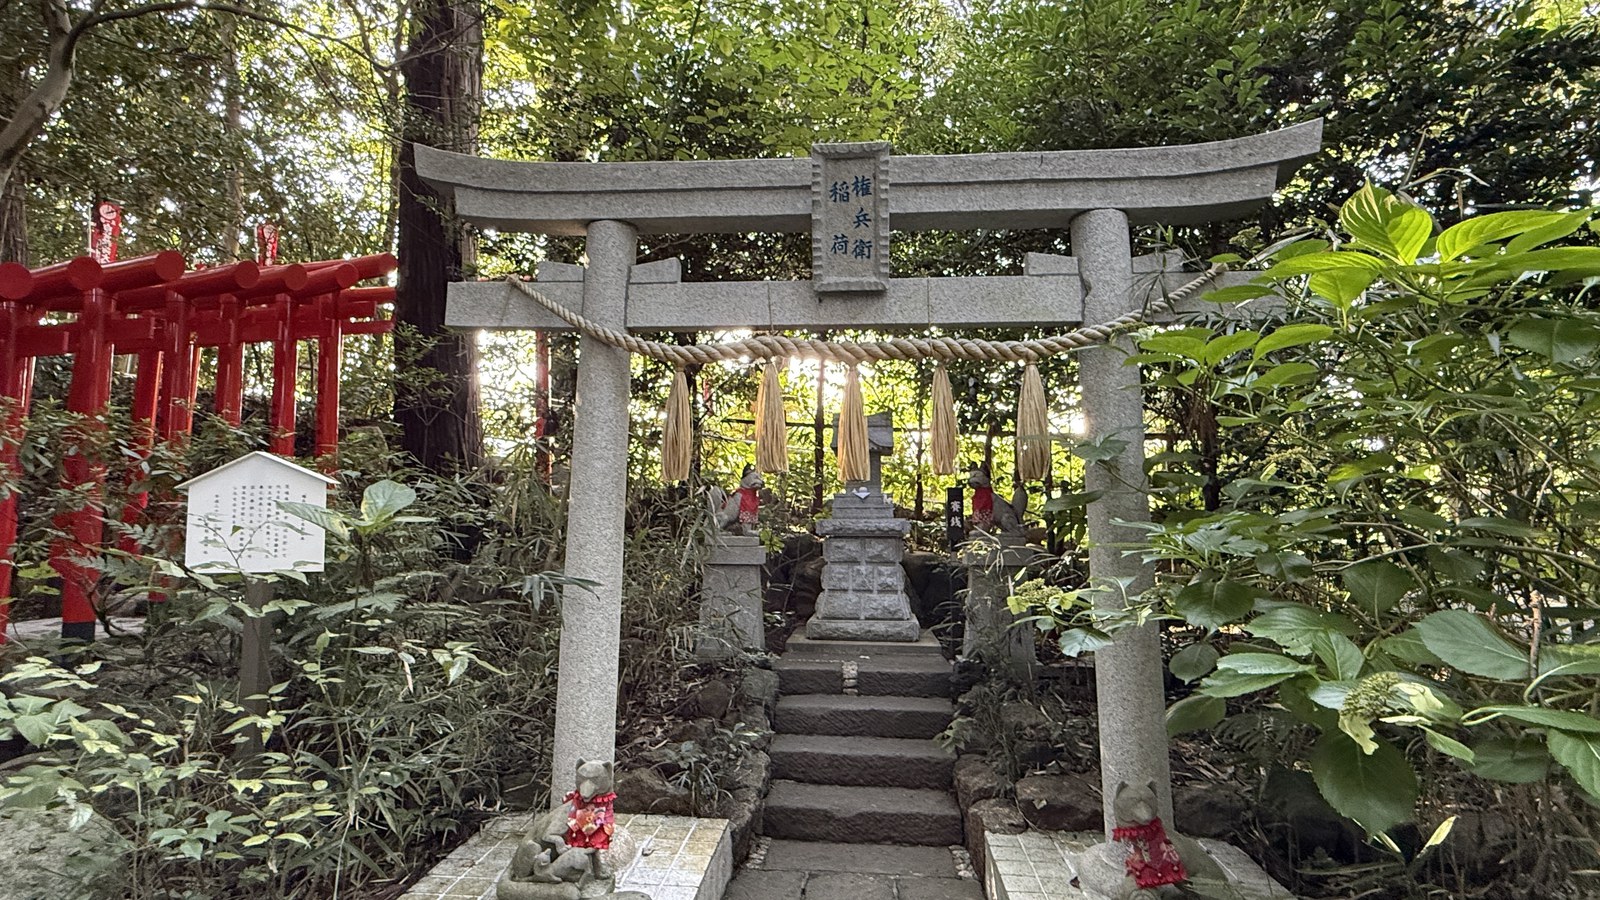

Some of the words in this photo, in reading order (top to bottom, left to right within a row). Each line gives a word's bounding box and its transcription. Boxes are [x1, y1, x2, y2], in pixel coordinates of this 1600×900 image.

[829, 181, 850, 255] 稲荷
[852, 175, 872, 259] 権兵衛
